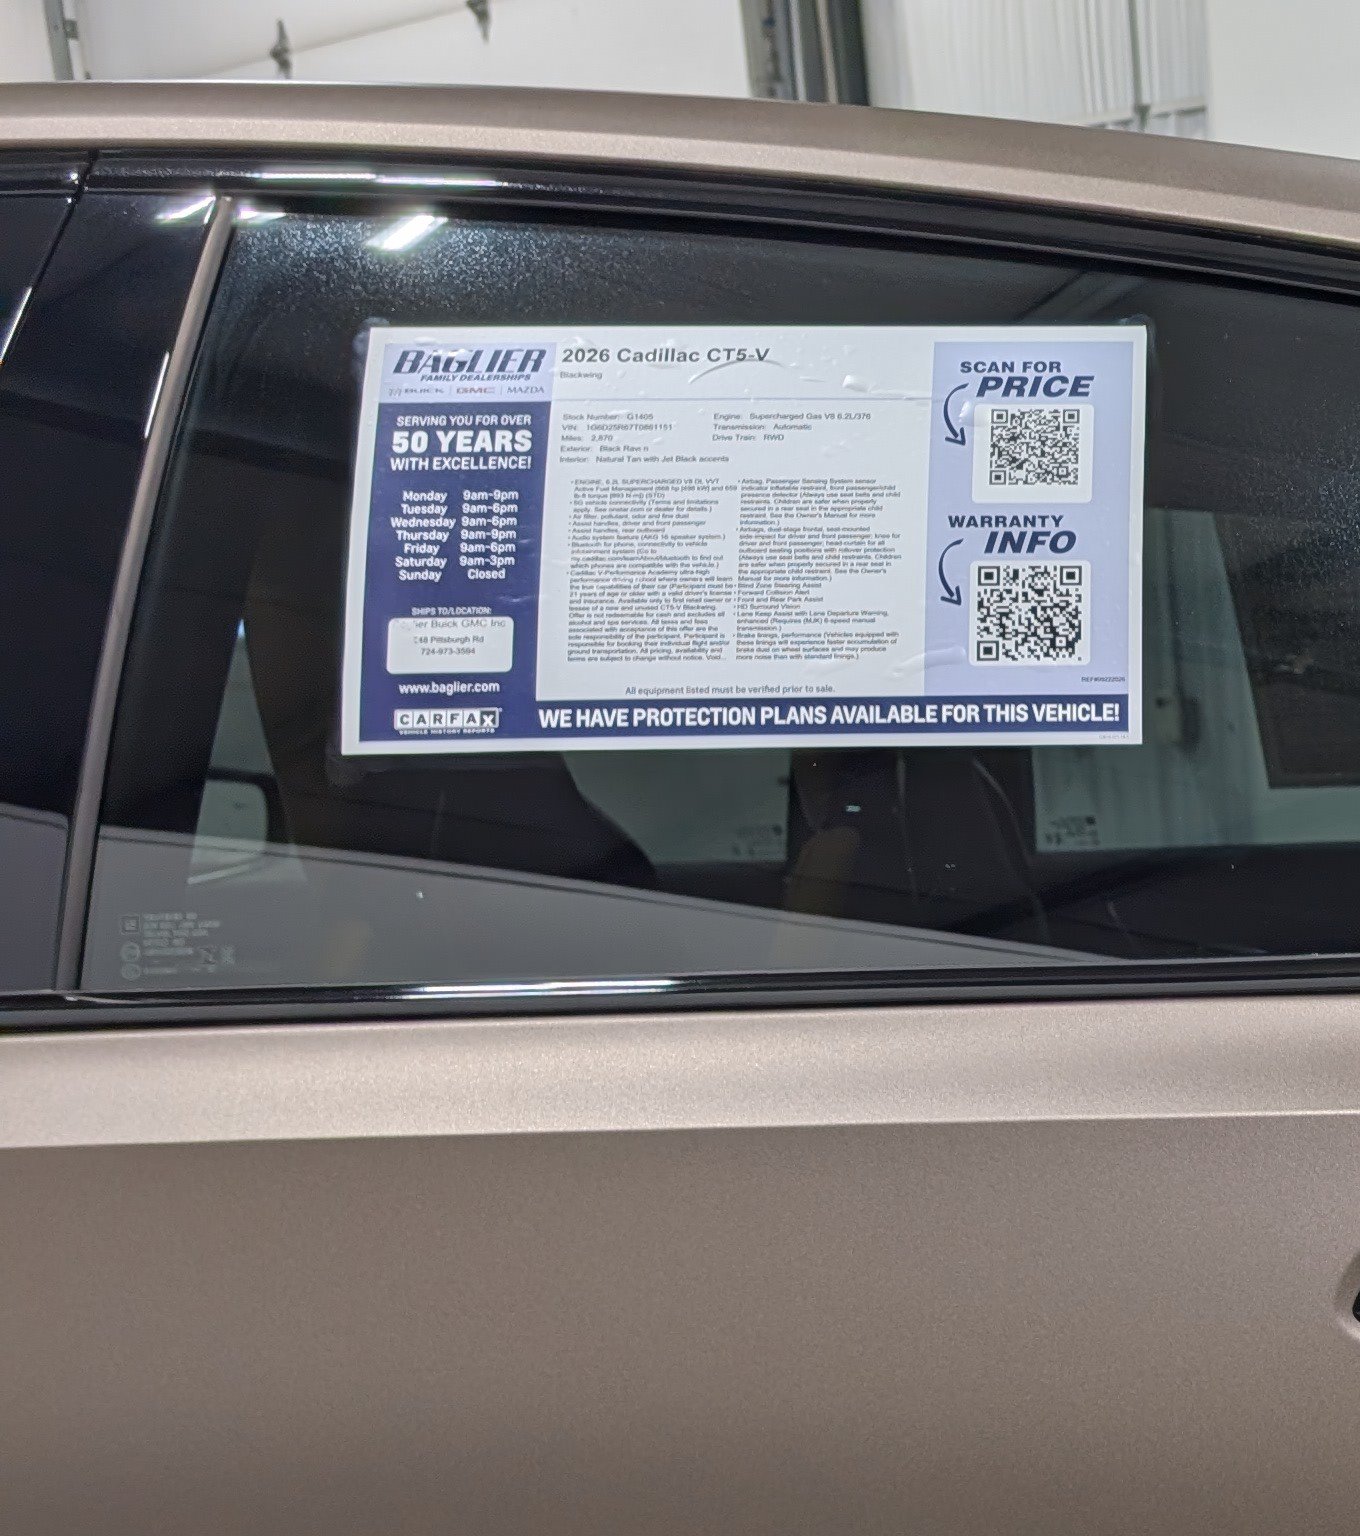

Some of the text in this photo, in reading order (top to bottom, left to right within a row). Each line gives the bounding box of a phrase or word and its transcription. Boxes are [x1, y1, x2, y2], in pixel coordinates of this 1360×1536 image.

[393, 349, 547, 374] BAGLIER
[562, 348, 770, 363] 2026 Cadillac CT5-V
[960, 361, 1062, 373] SCAN FOR
[420, 373, 531, 382] FAMILY DEALERSHIPS
[560, 371, 603, 380] Blackwing
[507, 386, 545, 394] MAZDA
[976, 375, 1095, 397] PRICE
[397, 414, 532, 427] SERVING YOU FOR OVER
[563, 413, 585, 421] Stock
[587, 413, 619, 421] Number:
[714, 413, 742, 421] Engine:
[749, 413, 804, 421] Supercharged
[392, 430, 533, 453] 50 YEARS
[561, 434, 584, 442] Miles:
[390, 456, 531, 471] WITH EXCELLENCE!
[403, 489, 519, 503] Monday 9am-9pm
[401, 503, 518, 516] Tuesday 9am-6pm
[390, 516, 518, 529] Wednesday 9am-6pm
[948, 515, 1064, 527] WARRANTY
[395, 529, 517, 542] Thursday 9am-9pm
[984, 530, 1077, 554] INFO
[404, 542, 516, 555] Friday 9am-6pm
[395, 555, 516, 569] Saturday 9am-3pm
[399, 568, 506, 582] Sunday Closed
[411, 607, 436, 615] SHIPS
[461, 620, 487, 628] GMC
[491, 619, 506, 628] Inc
[430, 636, 471, 645] Pittsburgh
[399, 681, 500, 696] www.baglier.com
[625, 686, 636, 695] All
[638, 686, 684, 697] equipment
[686, 686, 710, 695] listed
[712, 686, 733, 695] must
[735, 686, 746, 695] be
[748, 685, 780, 694] verified
[782, 685, 802, 695] prior
[816, 685, 836, 693] sale.
[397, 709, 499, 728] CARFAX
[539, 703, 1120, 728] WE HAVE PROTECTION PLANS AVAILABLE FOR THIS VEHICLE!
